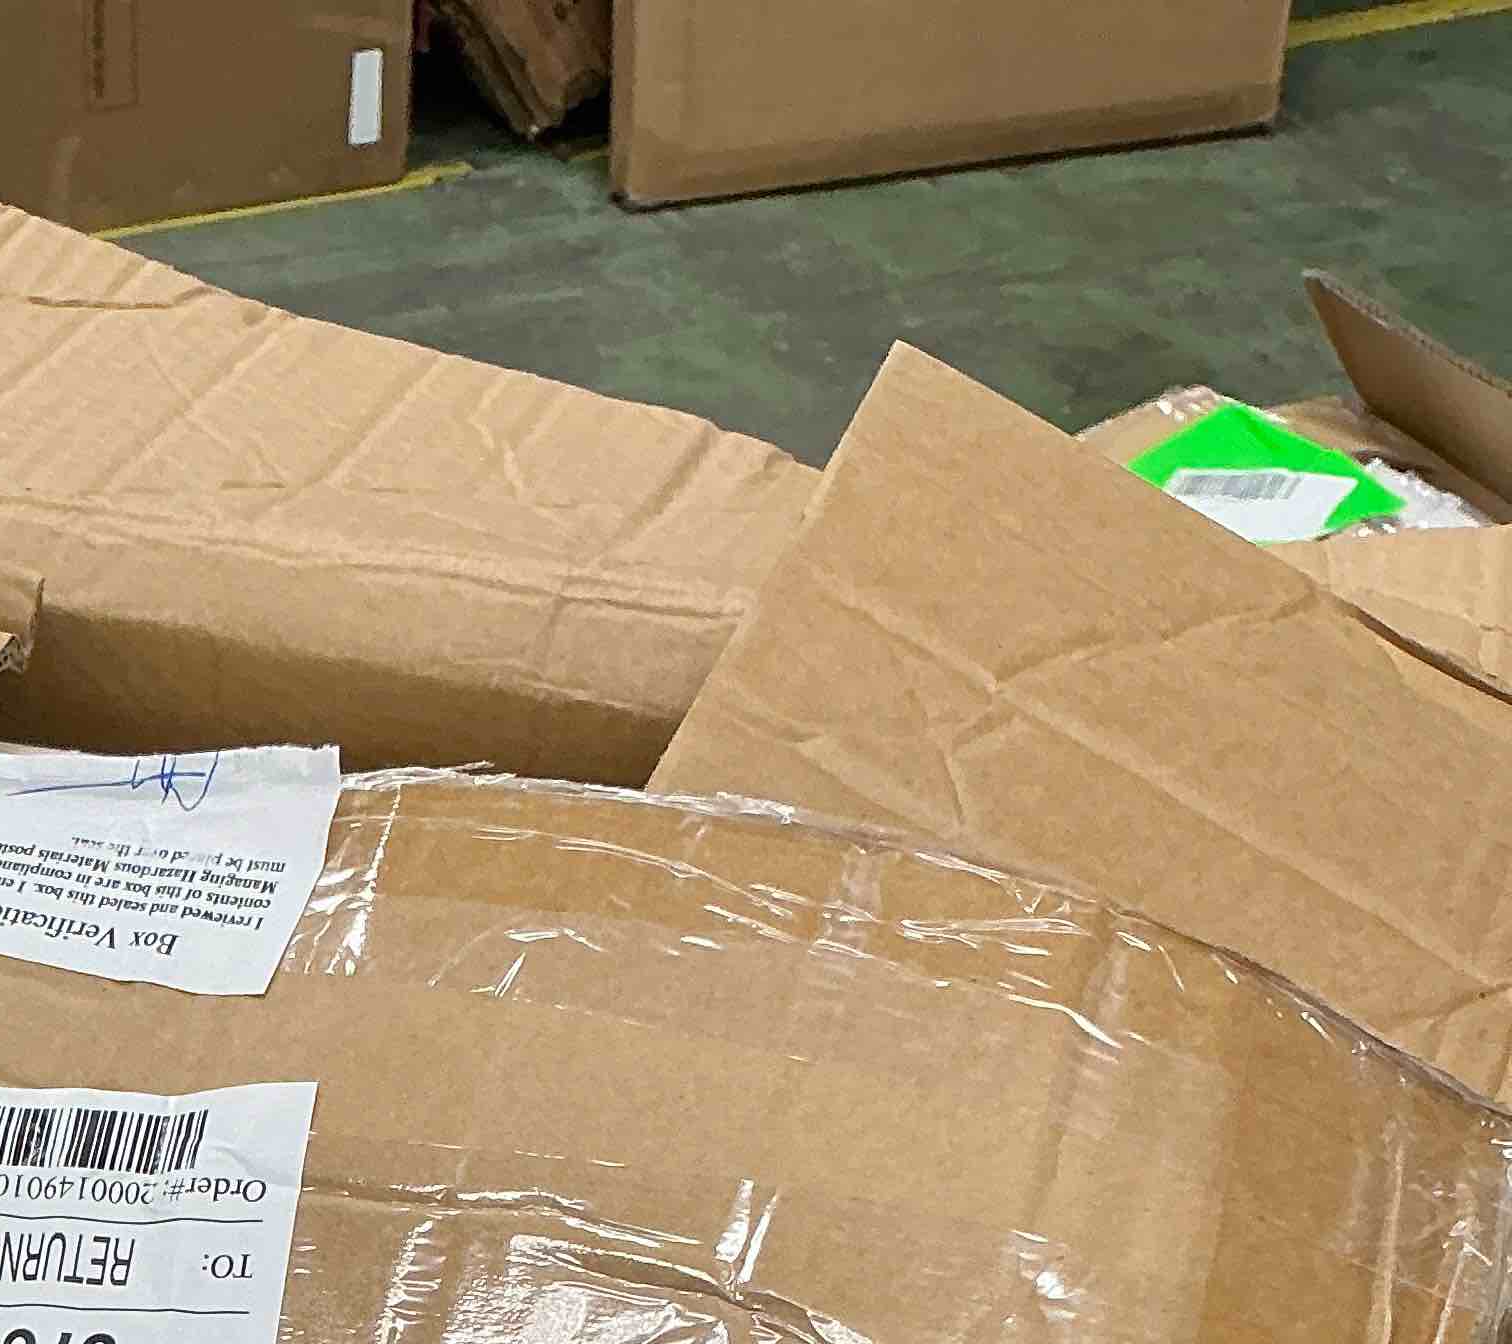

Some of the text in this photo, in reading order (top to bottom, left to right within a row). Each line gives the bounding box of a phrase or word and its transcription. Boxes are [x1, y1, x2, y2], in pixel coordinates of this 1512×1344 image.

[38, 848, 110, 873] Materials
[225, 858, 243, 872] be
[247, 859, 286, 873] must
[76, 874, 91, 888] in
[115, 862, 196, 883] Hazardous
[17, 882, 26, 894] I
[94, 877, 121, 889] are
[125, 882, 151, 897] box
[201, 870, 278, 894] Managing
[33, 883, 62, 900] box.
[67, 890, 96, 907] this
[155, 885, 182, 900] this
[184, 888, 202, 902] of
[98, 895, 146, 913] sealed
[148, 903, 178, 916] and
[206, 892, 271, 911] contents
[181, 906, 252, 929] reviewed
[254, 917, 264, 931] I
[129, 931, 178, 956] Box
[0, 1231, 136, 1287] RETURN
[202, 1253, 252, 1279] TO:
